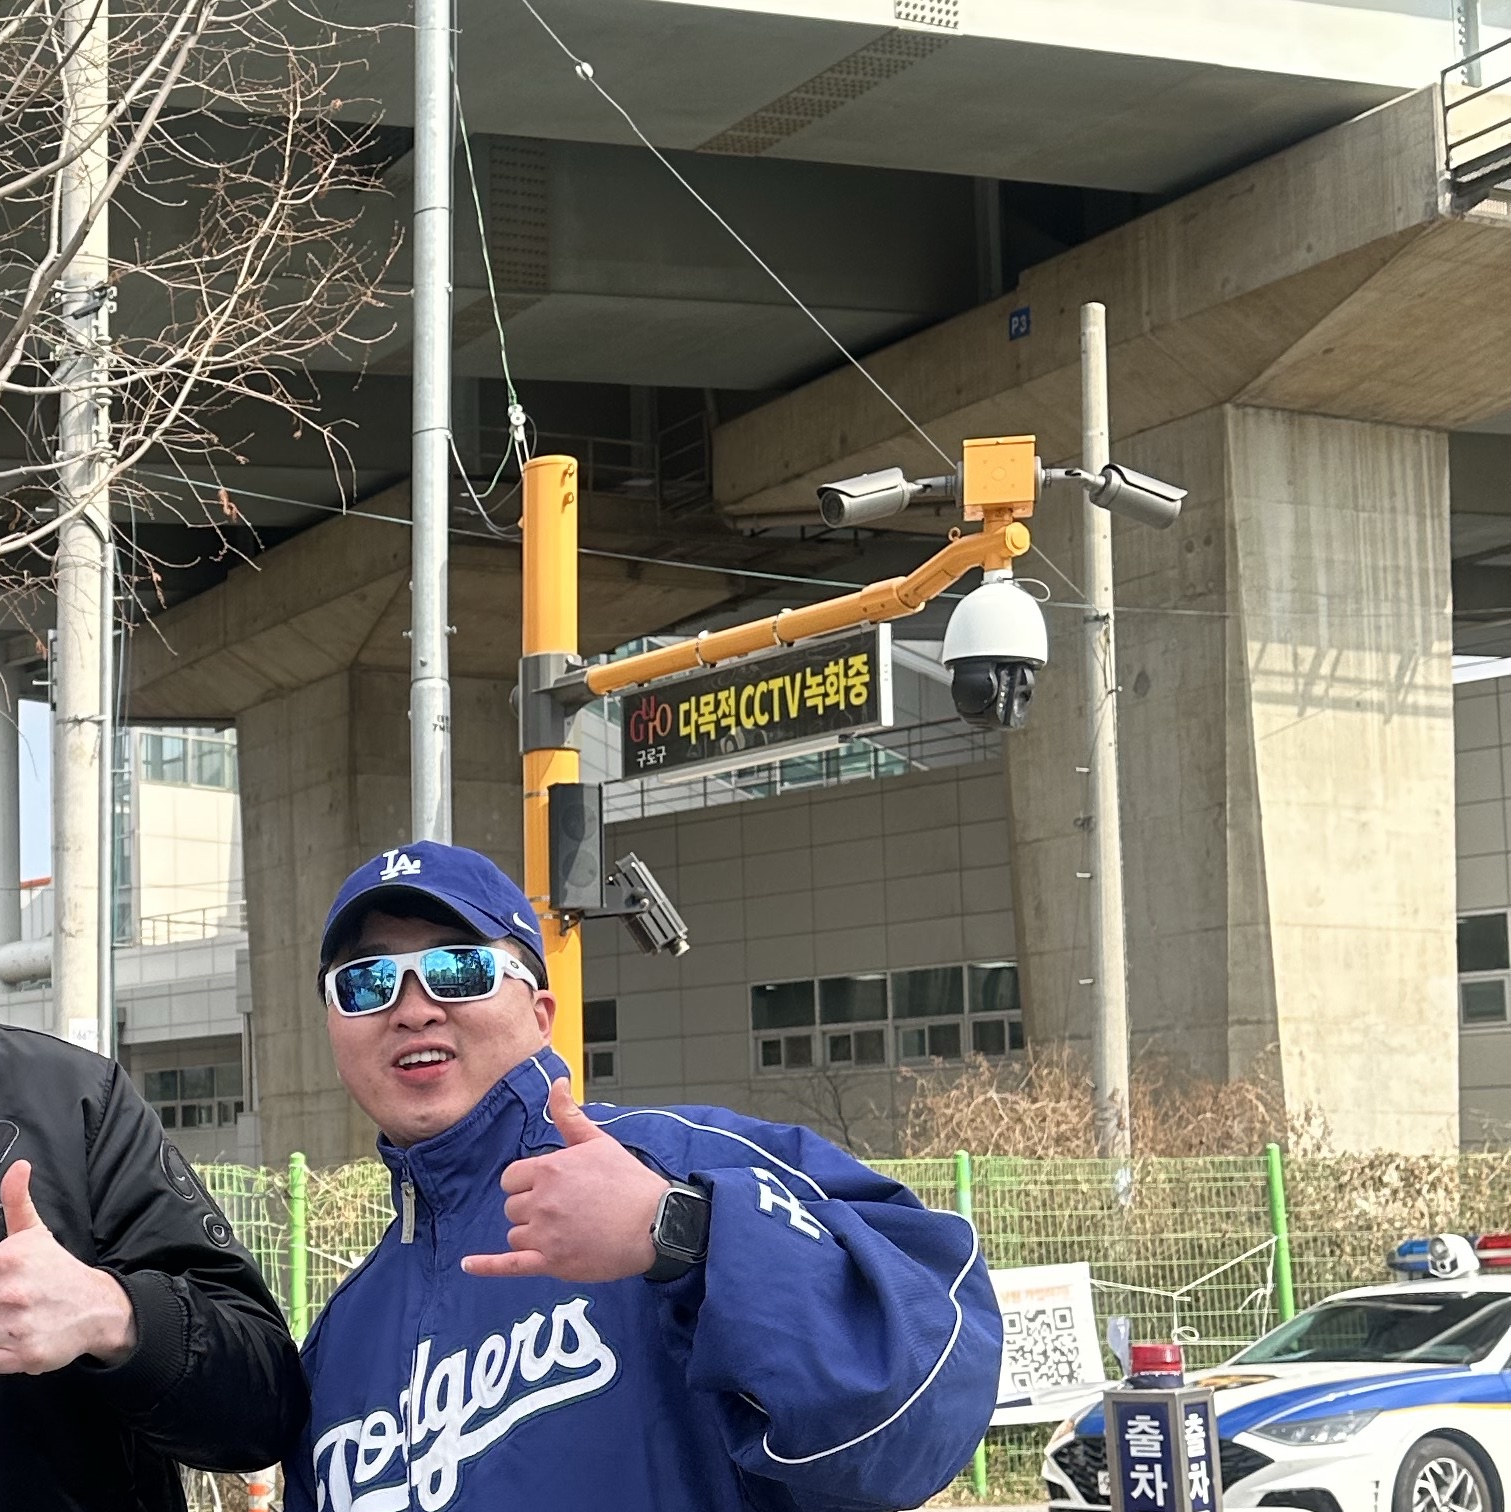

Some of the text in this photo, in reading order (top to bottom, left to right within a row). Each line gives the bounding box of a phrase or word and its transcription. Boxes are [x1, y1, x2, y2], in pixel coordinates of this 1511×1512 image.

[678, 653, 870, 745] 다목적 CCTV 녹화중
[636, 745, 667, 769] 구로구
[379, 849, 421, 881] LA
